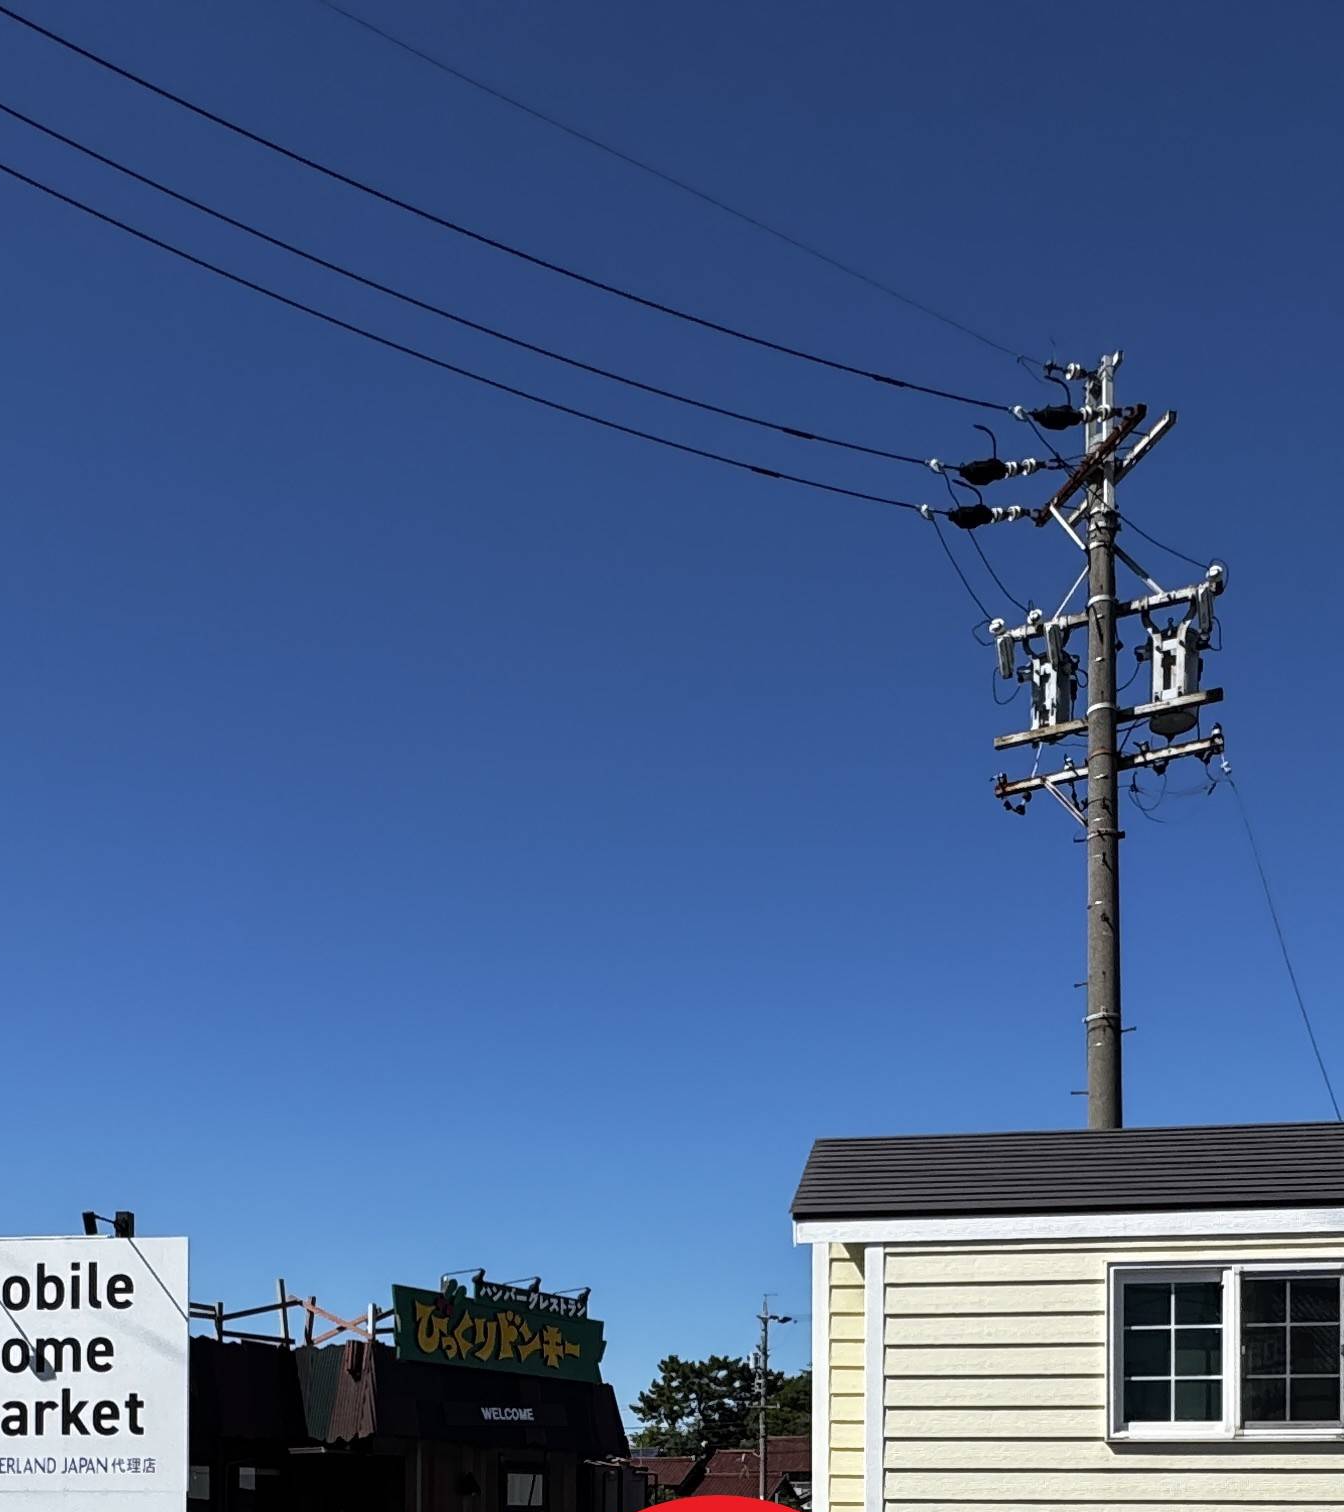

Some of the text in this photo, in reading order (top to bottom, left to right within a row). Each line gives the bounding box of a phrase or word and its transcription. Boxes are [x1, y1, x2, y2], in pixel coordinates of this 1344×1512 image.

[480, 1285, 585, 1318] ハンバーグレストラン
[415, 1300, 580, 1368] びっくりドンキー
[480, 1407, 535, 1421] WELCOME
[61, 1457, 108, 1474] JAPAN
[111, 1457, 156, 1474] 代理店
